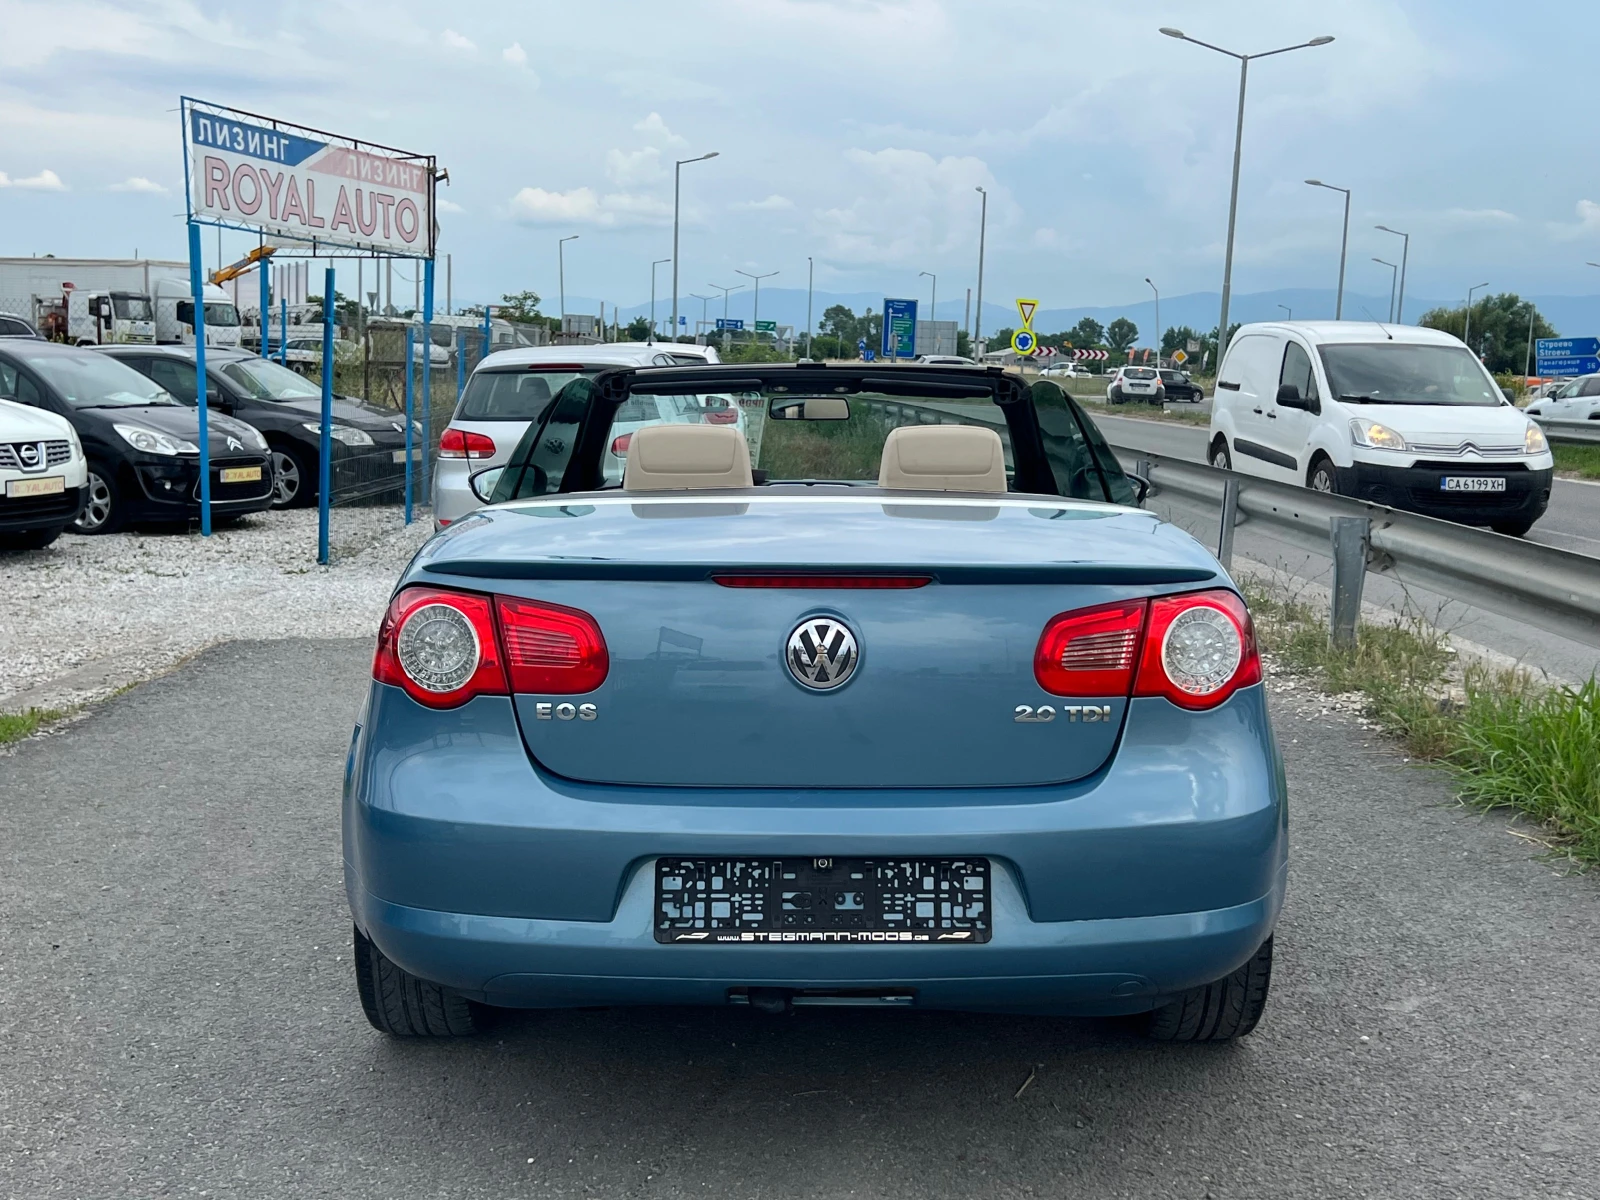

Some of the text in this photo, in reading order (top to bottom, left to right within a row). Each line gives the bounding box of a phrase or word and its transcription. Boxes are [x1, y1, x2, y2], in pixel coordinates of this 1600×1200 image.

[198, 117, 290, 161] ЛИЗИНГ
[346, 154, 422, 190] ЛИЗИНГ
[204, 155, 420, 244] ROYAL AUTO
[1539, 341, 1573, 349] Строево
[1540, 349, 1571, 357] Stroevo
[14, 482, 42, 495] RYAL
[1447, 479, 1504, 490] CA 6199 XH
[536, 702, 598, 721] EOS
[1064, 705, 1111, 723] TDI
